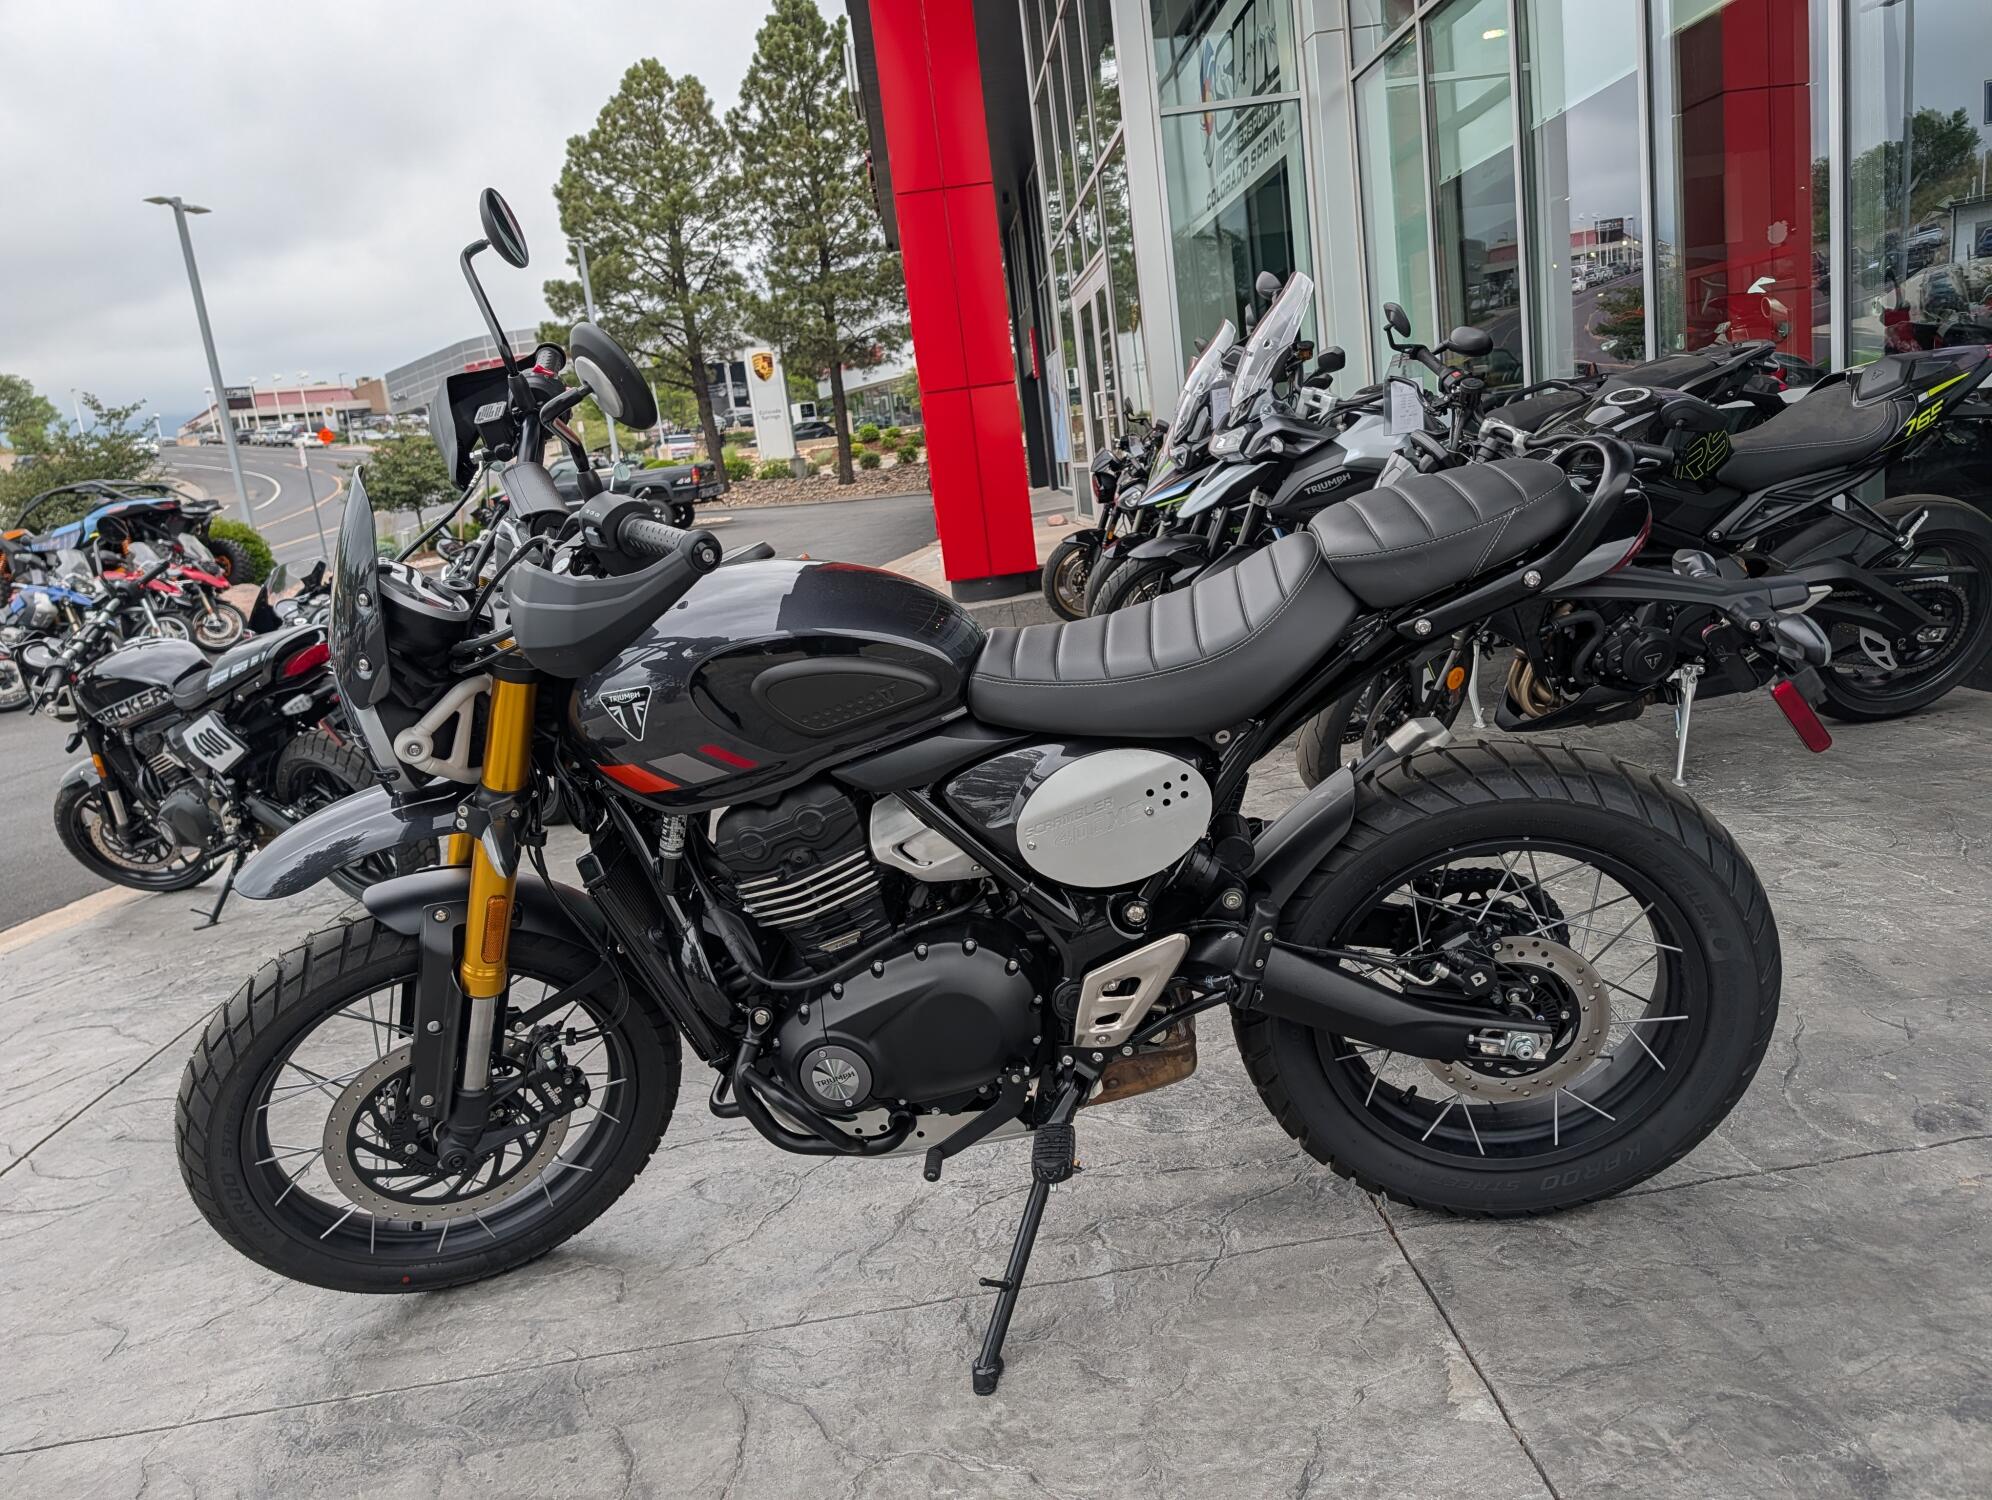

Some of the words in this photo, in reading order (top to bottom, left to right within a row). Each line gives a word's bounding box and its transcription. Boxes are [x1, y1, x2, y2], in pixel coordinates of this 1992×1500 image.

[1207, 156, 1249, 212] COLORADO
[1905, 399, 1945, 438] 765
[1304, 473, 1352, 495] TRIUMPH
[609, 691, 641, 704] TRIUMPH
[193, 727, 231, 759] 400
[1024, 797, 1114, 838] SCRAMBLER
[541, 1082, 562, 1106] BYBRE
[815, 1071, 856, 1087] TRIUMPH
[1540, 1144, 1642, 1191] KAROO
